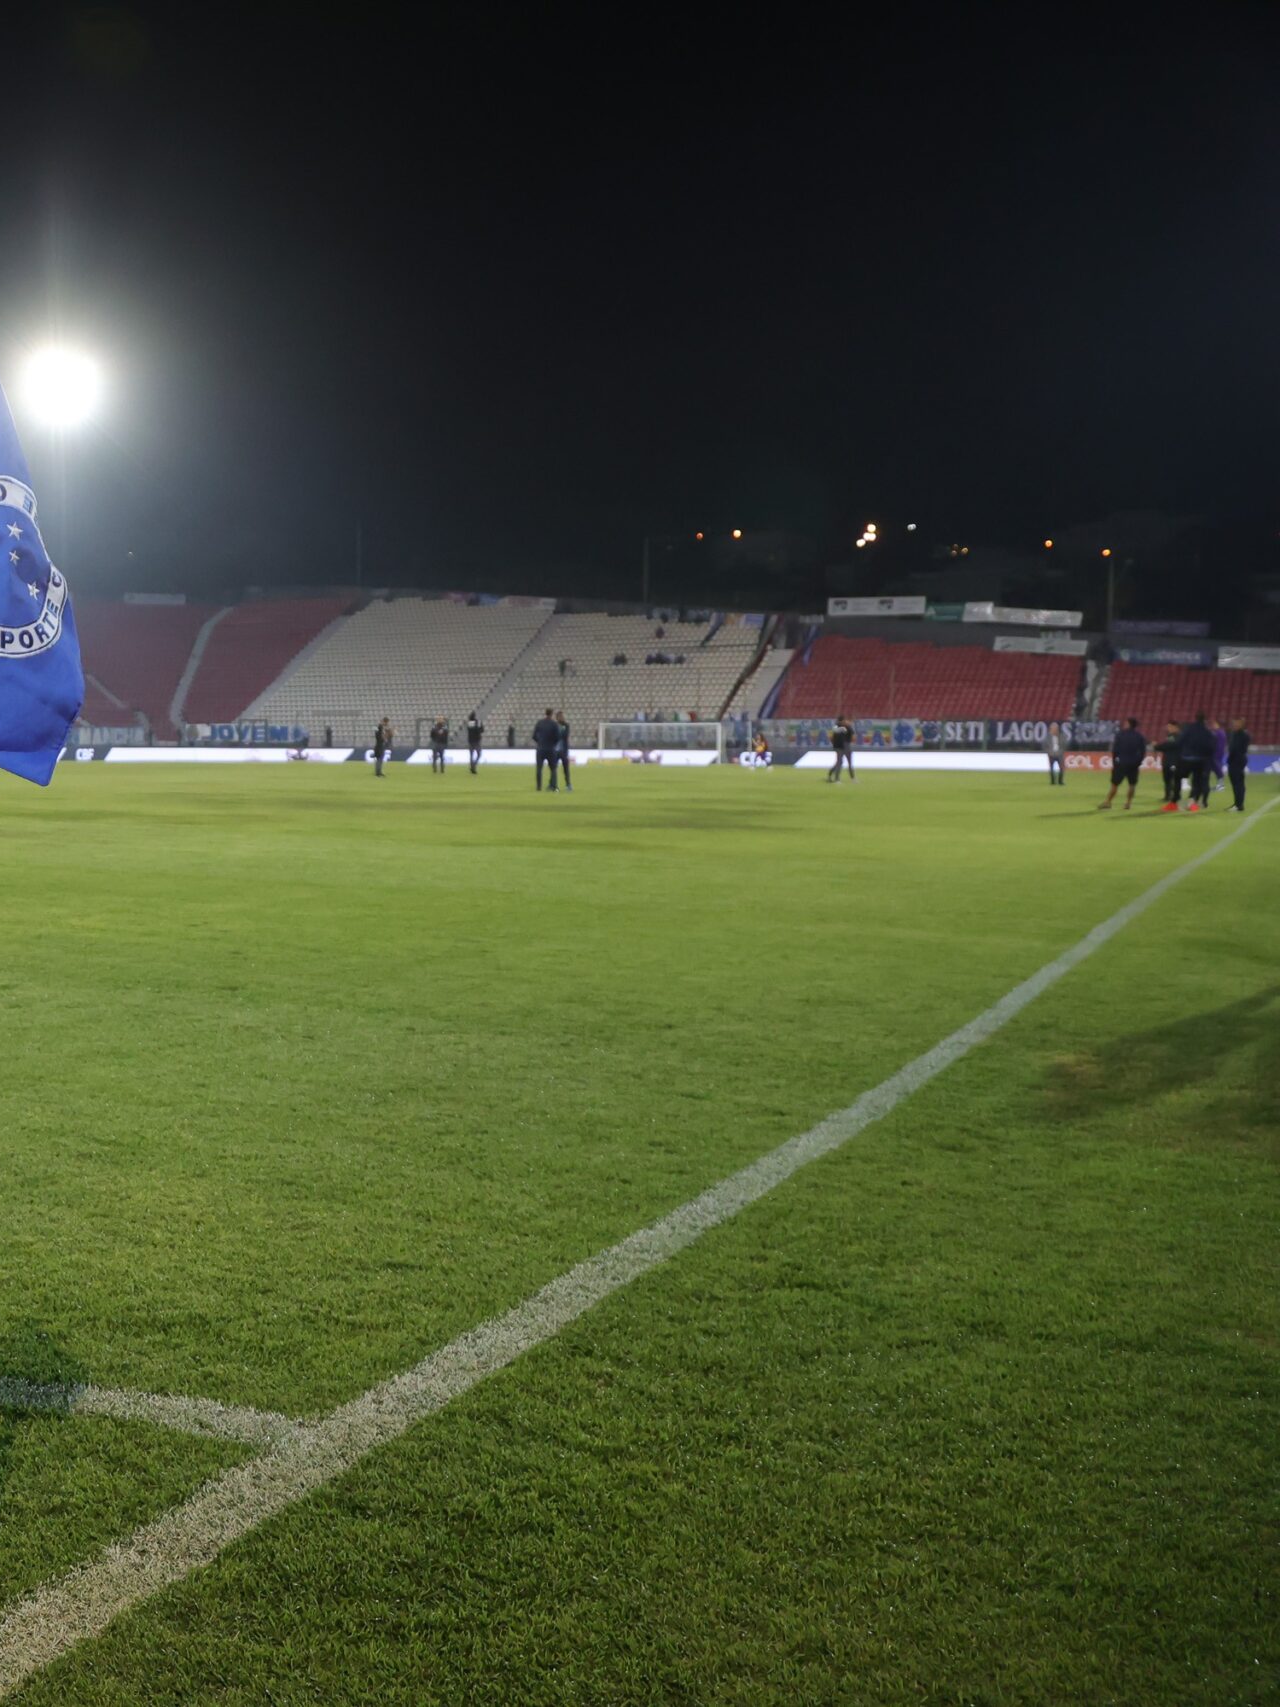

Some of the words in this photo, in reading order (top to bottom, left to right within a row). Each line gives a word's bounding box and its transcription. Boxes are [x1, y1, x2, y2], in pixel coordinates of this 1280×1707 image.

[204, 725, 289, 741] JOVEM
[995, 720, 1072, 741] LAGOS
[1064, 755, 1093, 769] GOL
